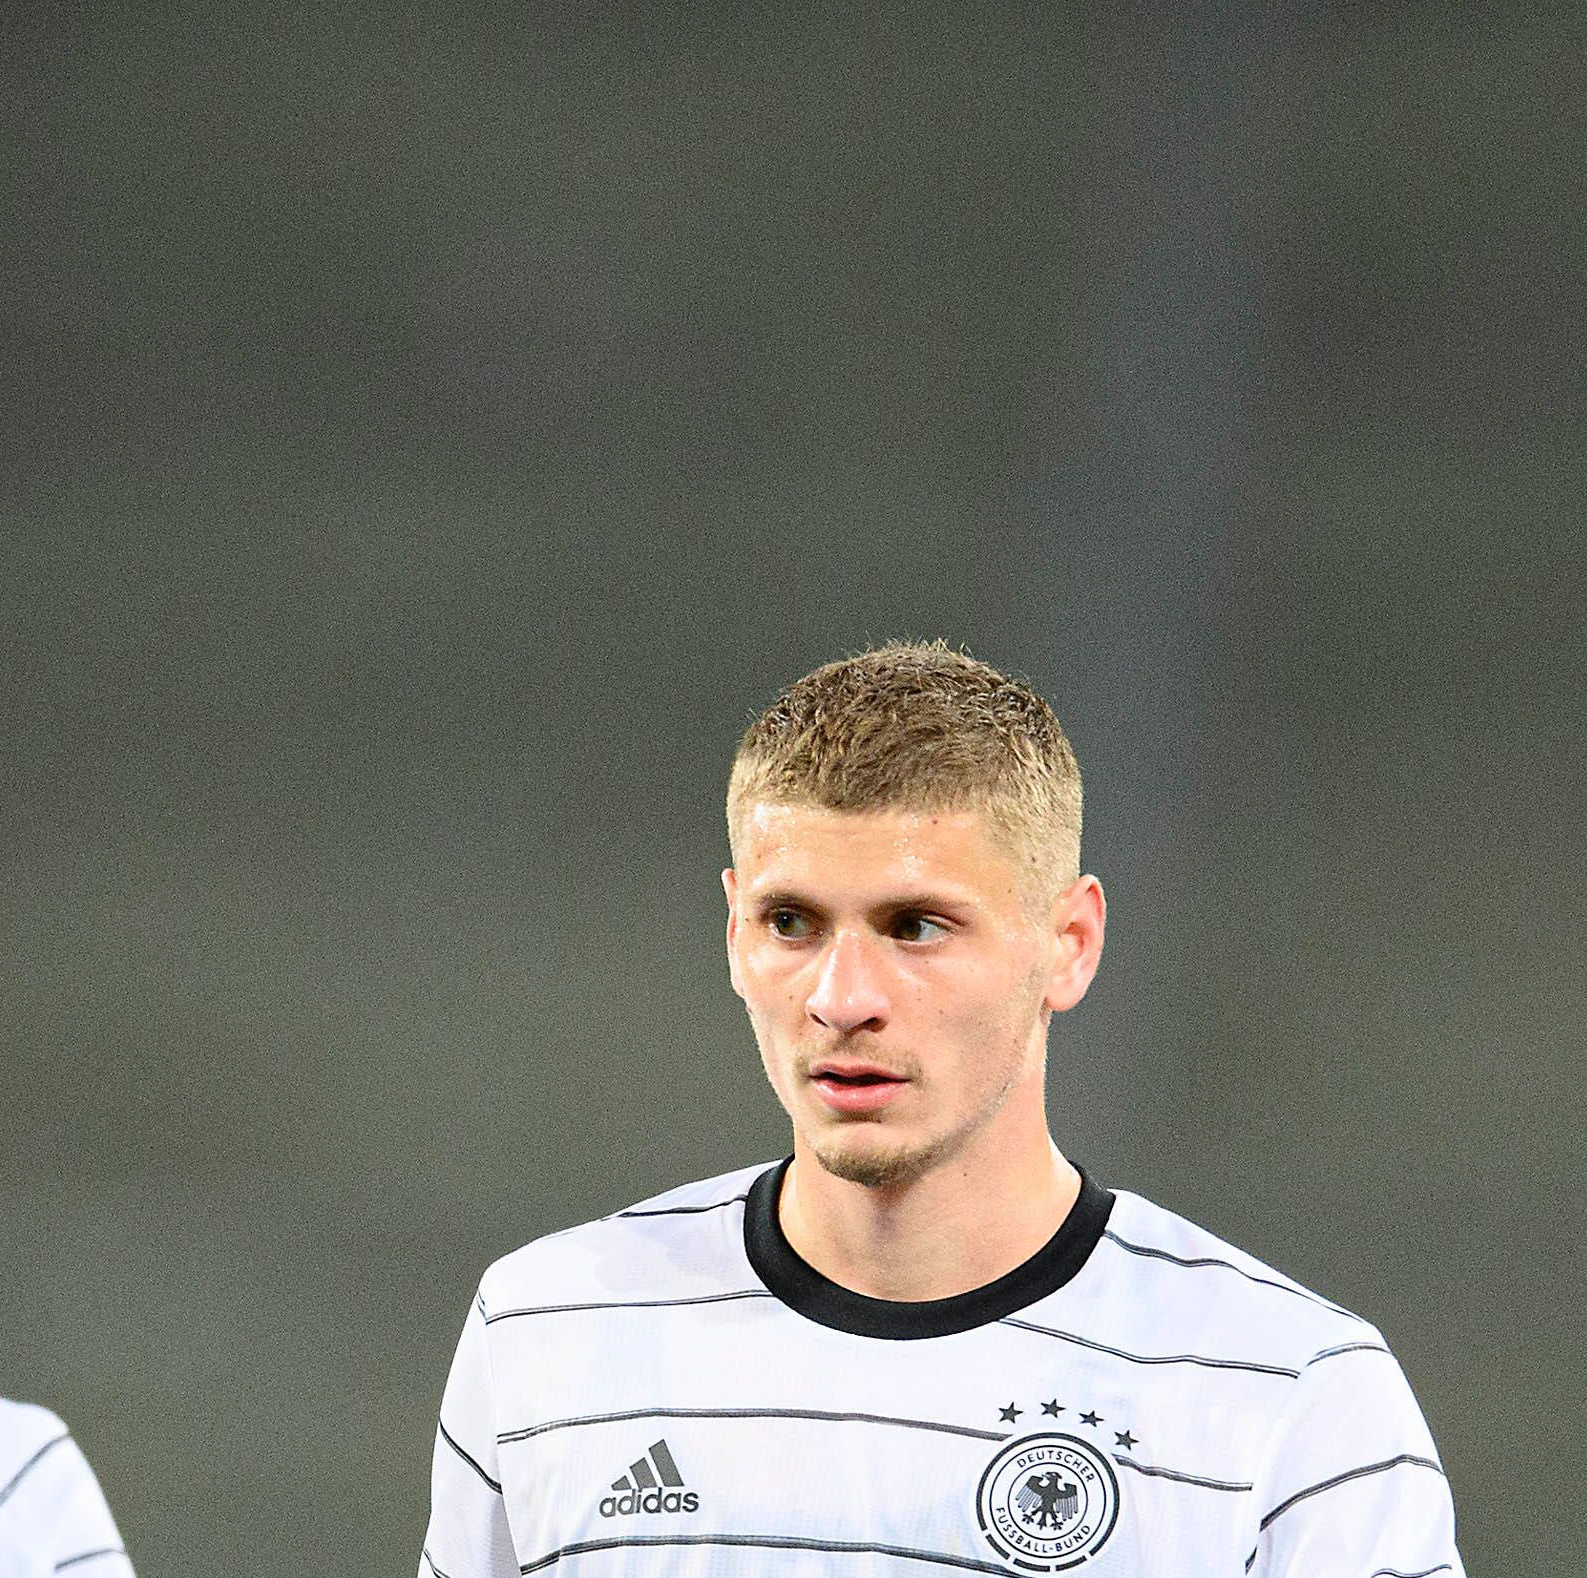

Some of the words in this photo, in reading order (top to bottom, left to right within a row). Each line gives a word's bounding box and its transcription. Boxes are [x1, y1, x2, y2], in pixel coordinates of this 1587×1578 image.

[1016, 1449, 1095, 1483] DEUTSCHER
[599, 1487, 700, 1518] adidas
[996, 1506, 1091, 1554] FUSSBALL-BUND
